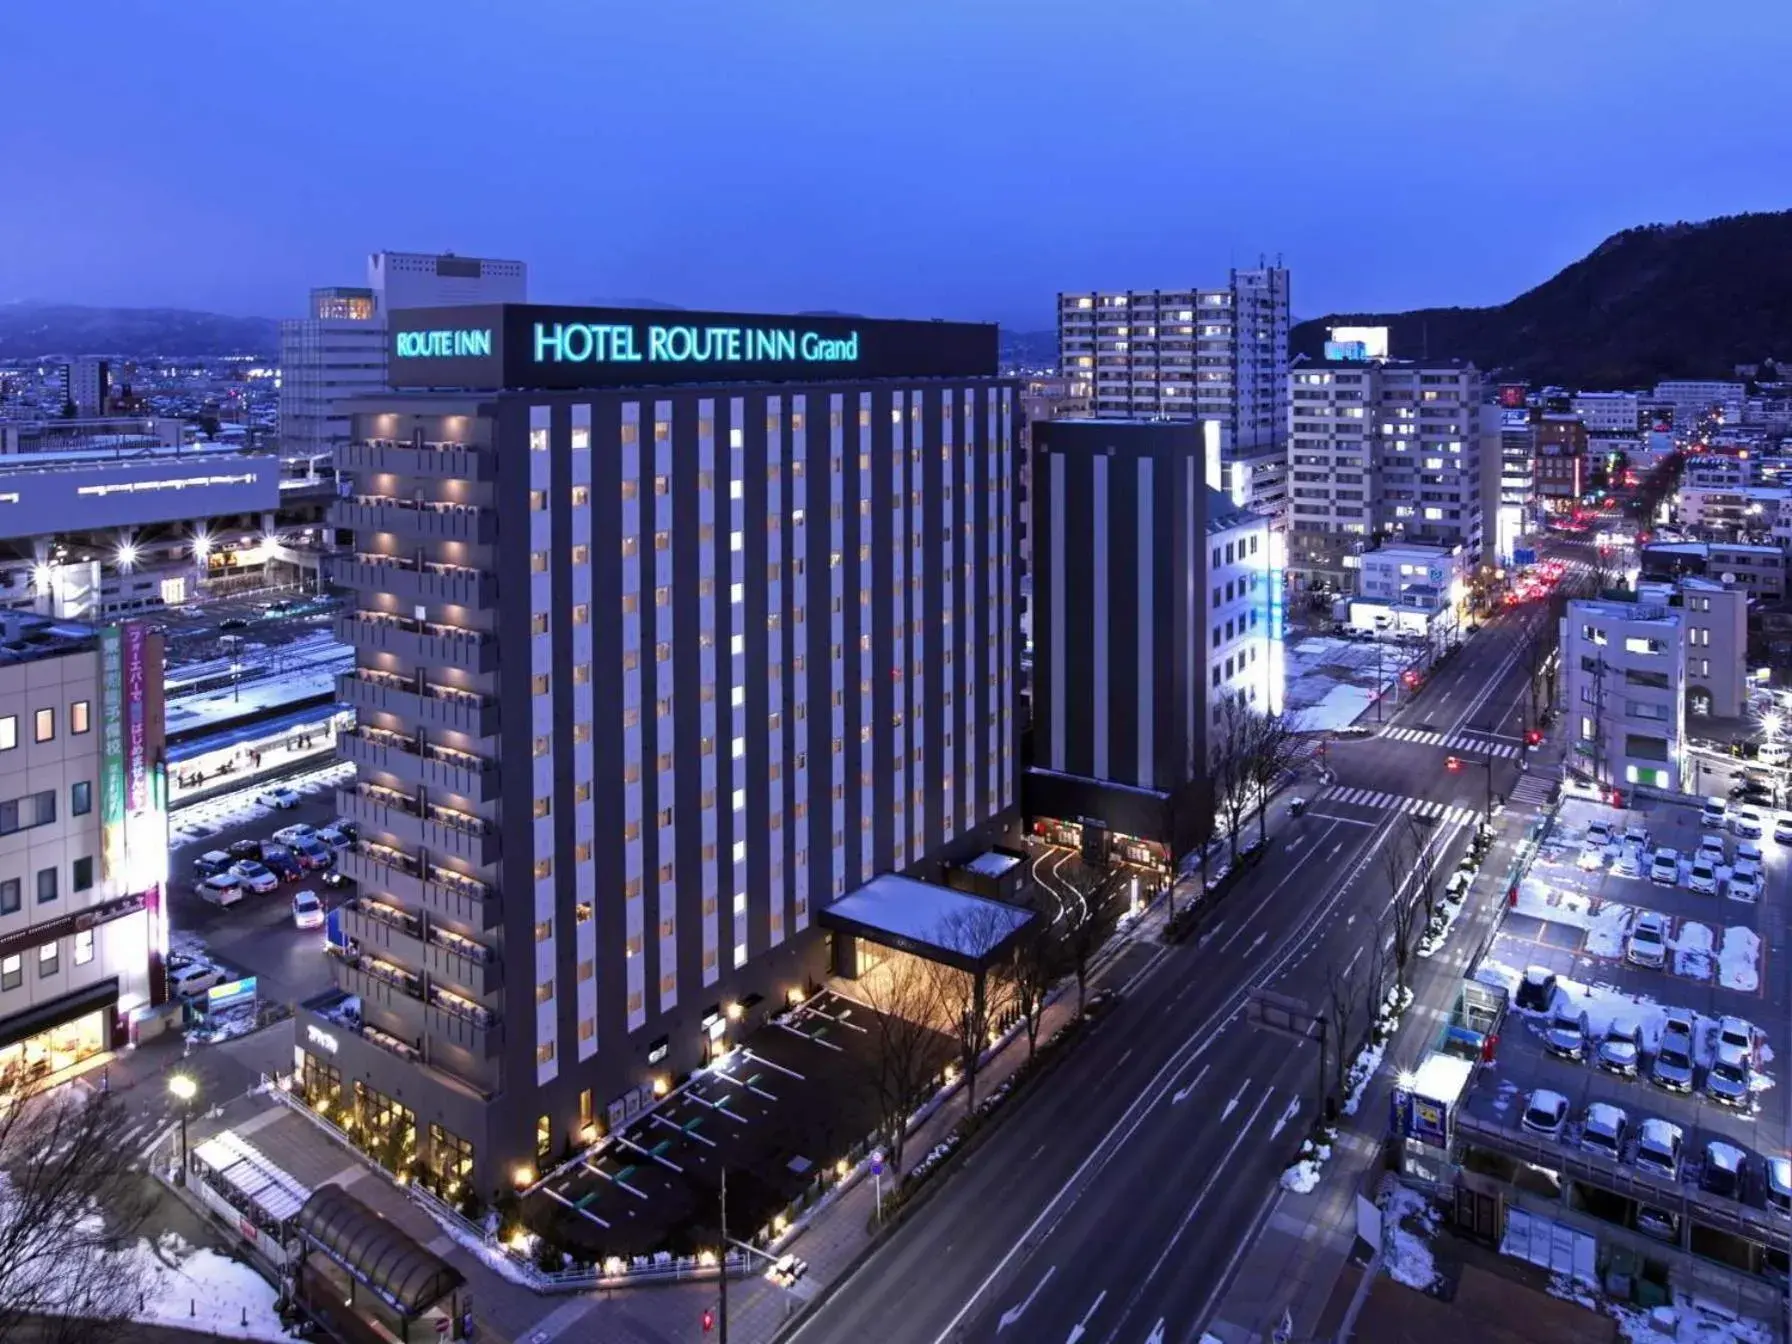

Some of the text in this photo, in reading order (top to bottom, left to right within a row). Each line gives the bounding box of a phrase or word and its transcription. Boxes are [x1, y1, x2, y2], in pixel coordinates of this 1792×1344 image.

[396, 329, 491, 357] ROUTE INN
[534, 322, 858, 362] HOTEL ROUTE INN Grand
